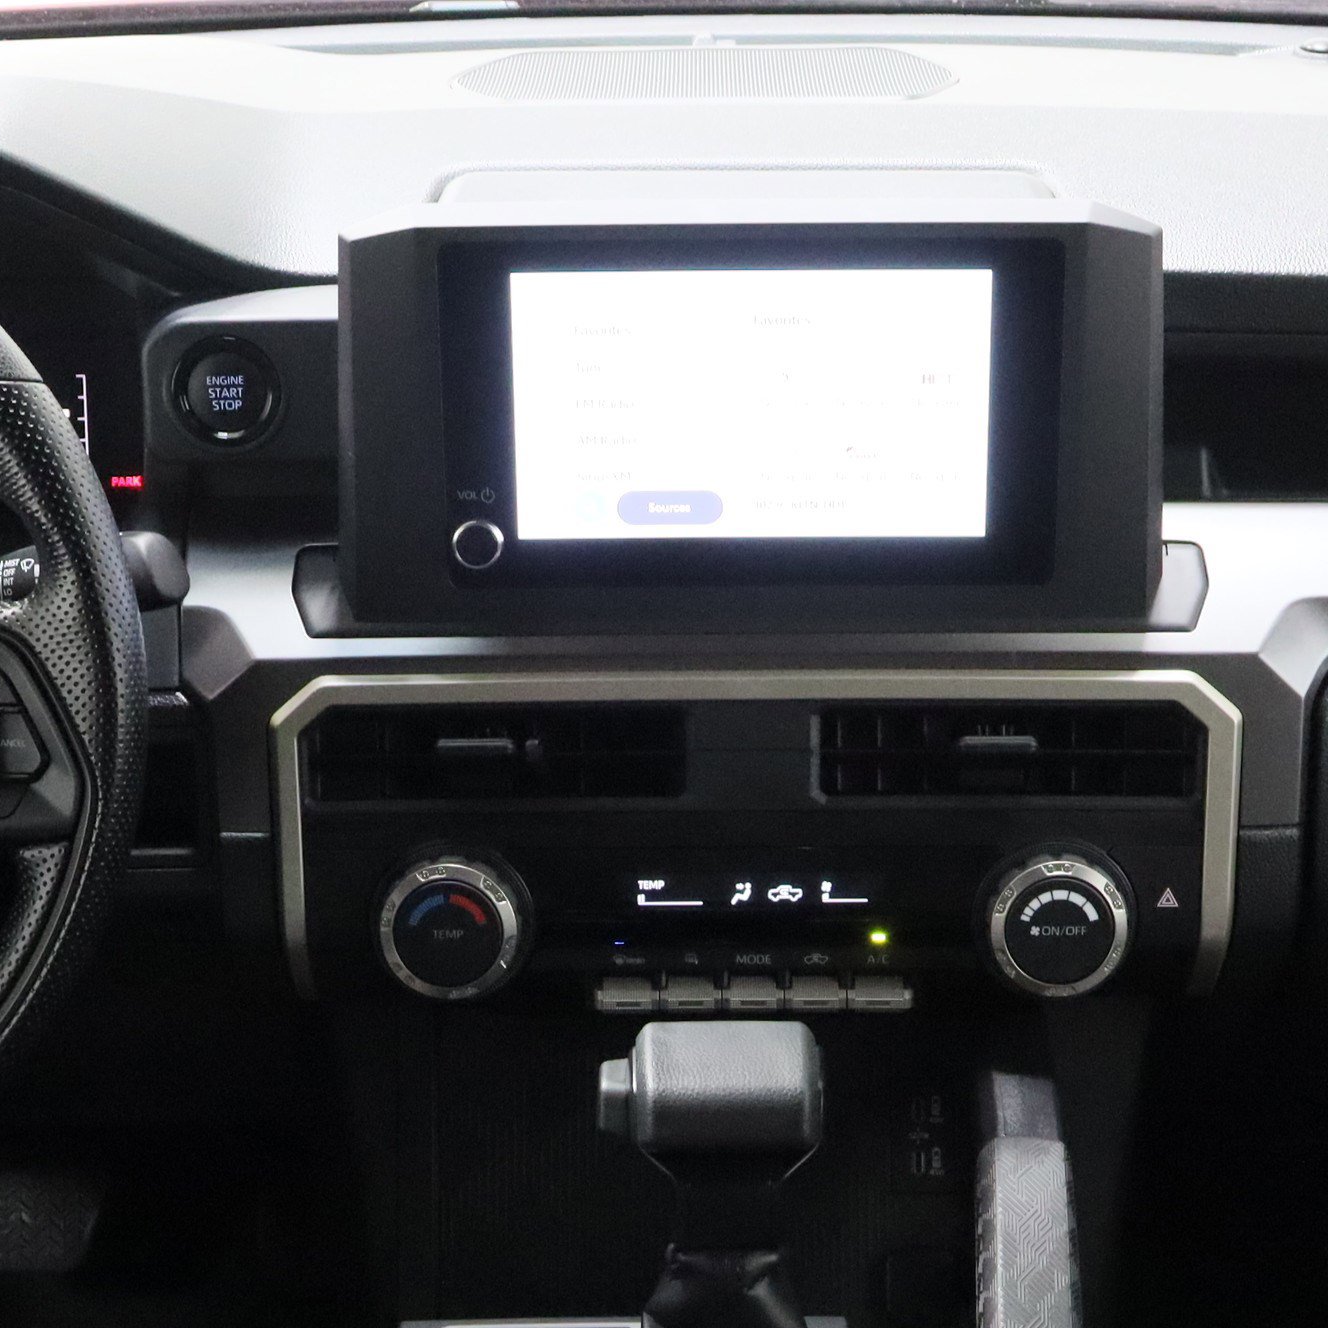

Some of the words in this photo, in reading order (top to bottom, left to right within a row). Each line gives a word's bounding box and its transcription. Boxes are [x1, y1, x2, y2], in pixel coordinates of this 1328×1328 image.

[206, 375, 244, 386] ENGINE
[208, 387, 244, 399] START
[212, 399, 243, 411] STOP
[111, 475, 142, 487] PARK
[457, 489, 479, 499] VOL
[648, 502, 692, 513] Sources
[3, 558, 20, 568] MIST
[3, 568, 16, 577] OFF
[3, 577, 14, 586] INT
[3, 588, 13, 596] LO
[637, 880, 665, 891] TEMP
[433, 929, 465, 939] TEMP
[1041, 925, 1087, 937] ON/OFF
[736, 954, 772, 965] MODE
[866, 953, 889, 965] A/C
